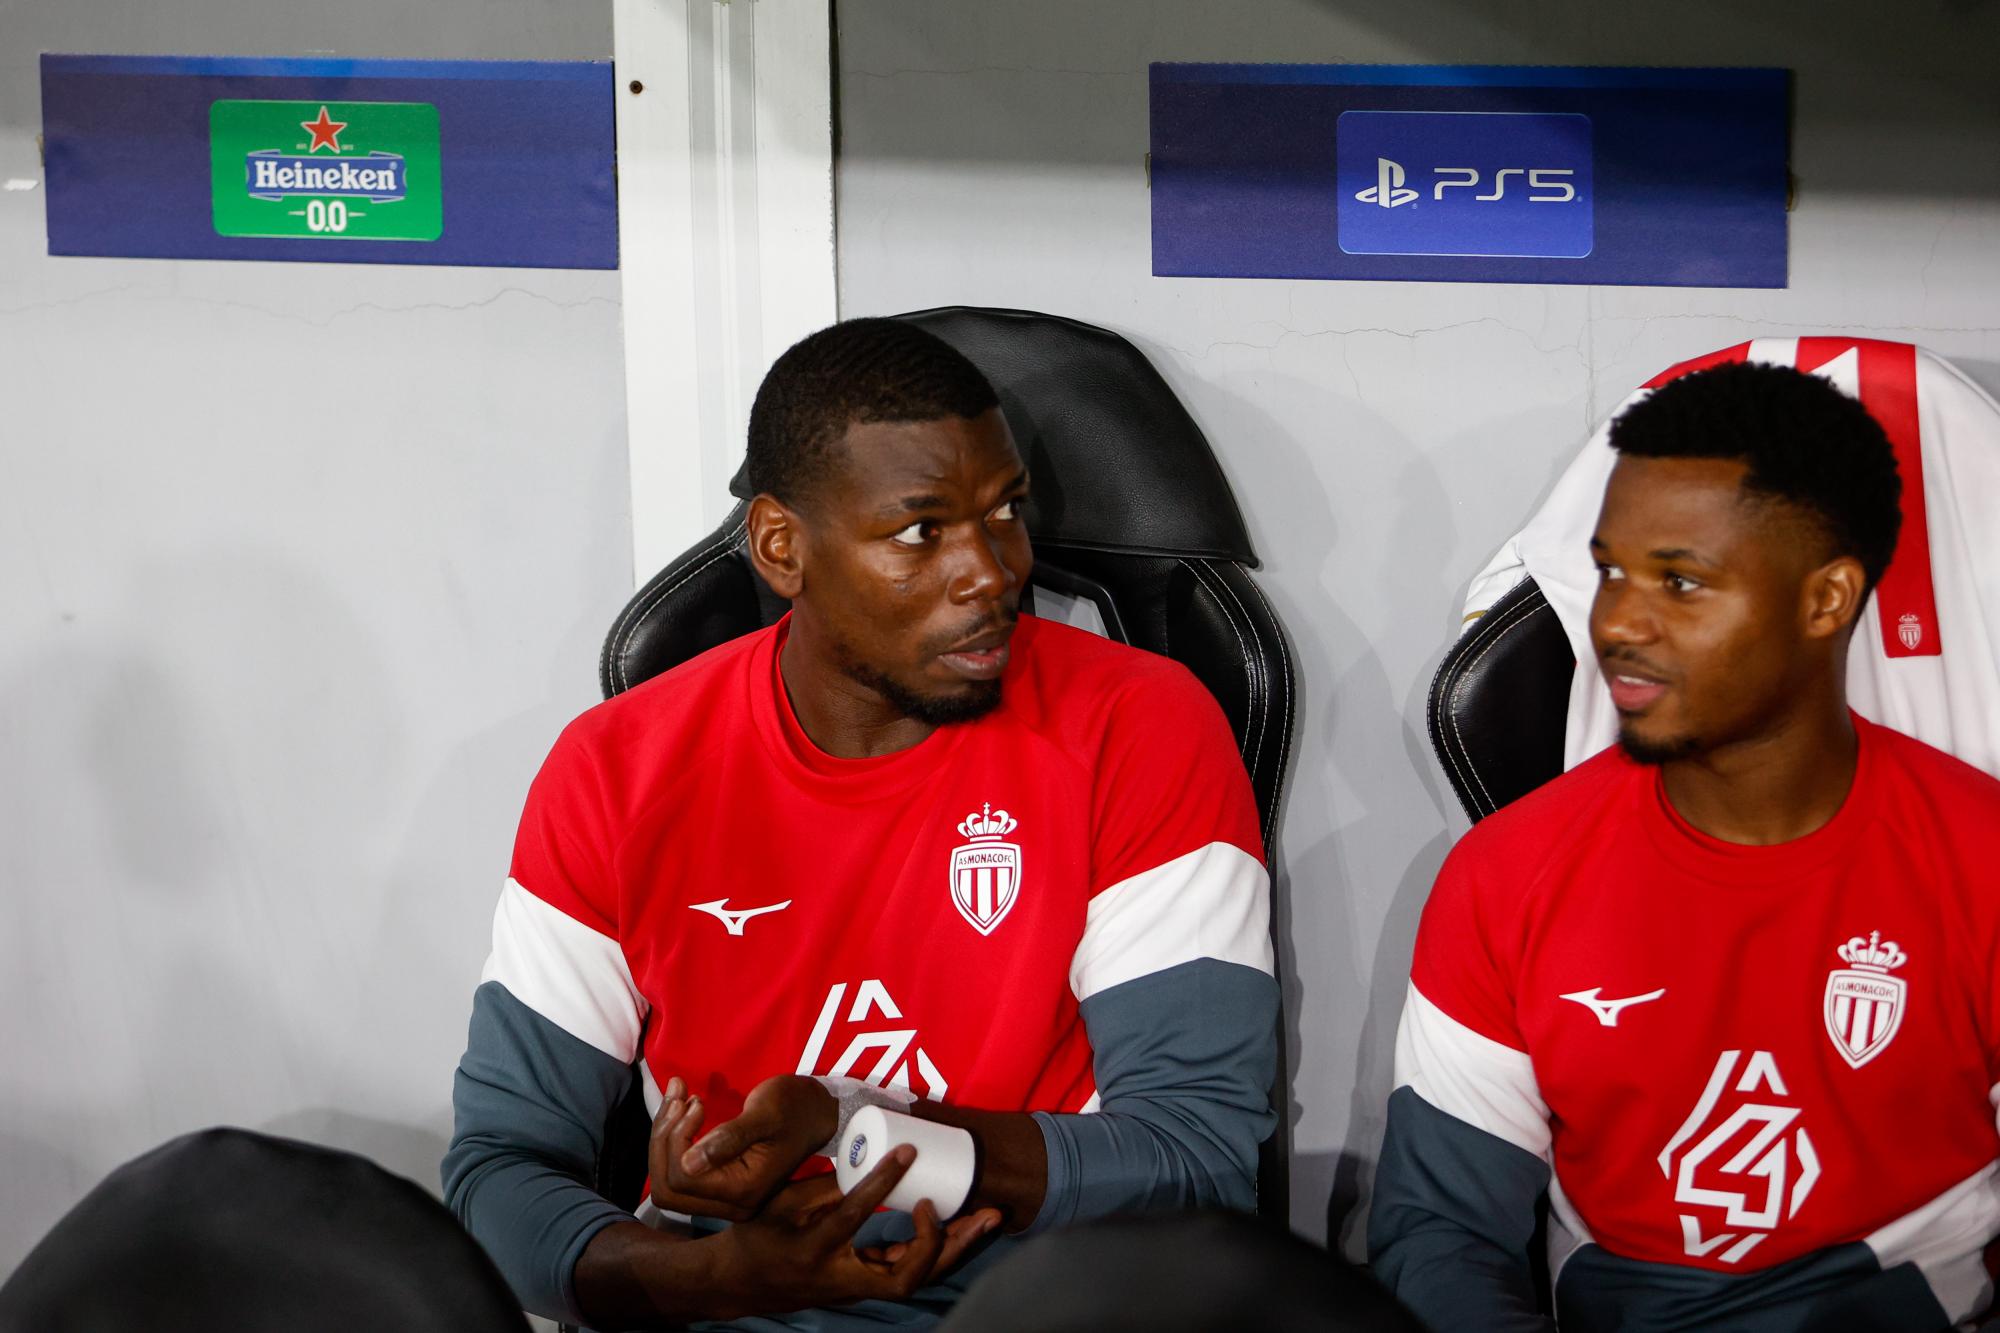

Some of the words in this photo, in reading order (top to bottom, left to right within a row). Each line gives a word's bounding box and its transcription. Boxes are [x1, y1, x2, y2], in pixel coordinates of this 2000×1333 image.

[254, 160, 397, 190] Heineken
[1433, 167, 1575, 202] PS5
[307, 200, 347, 232] 0.0
